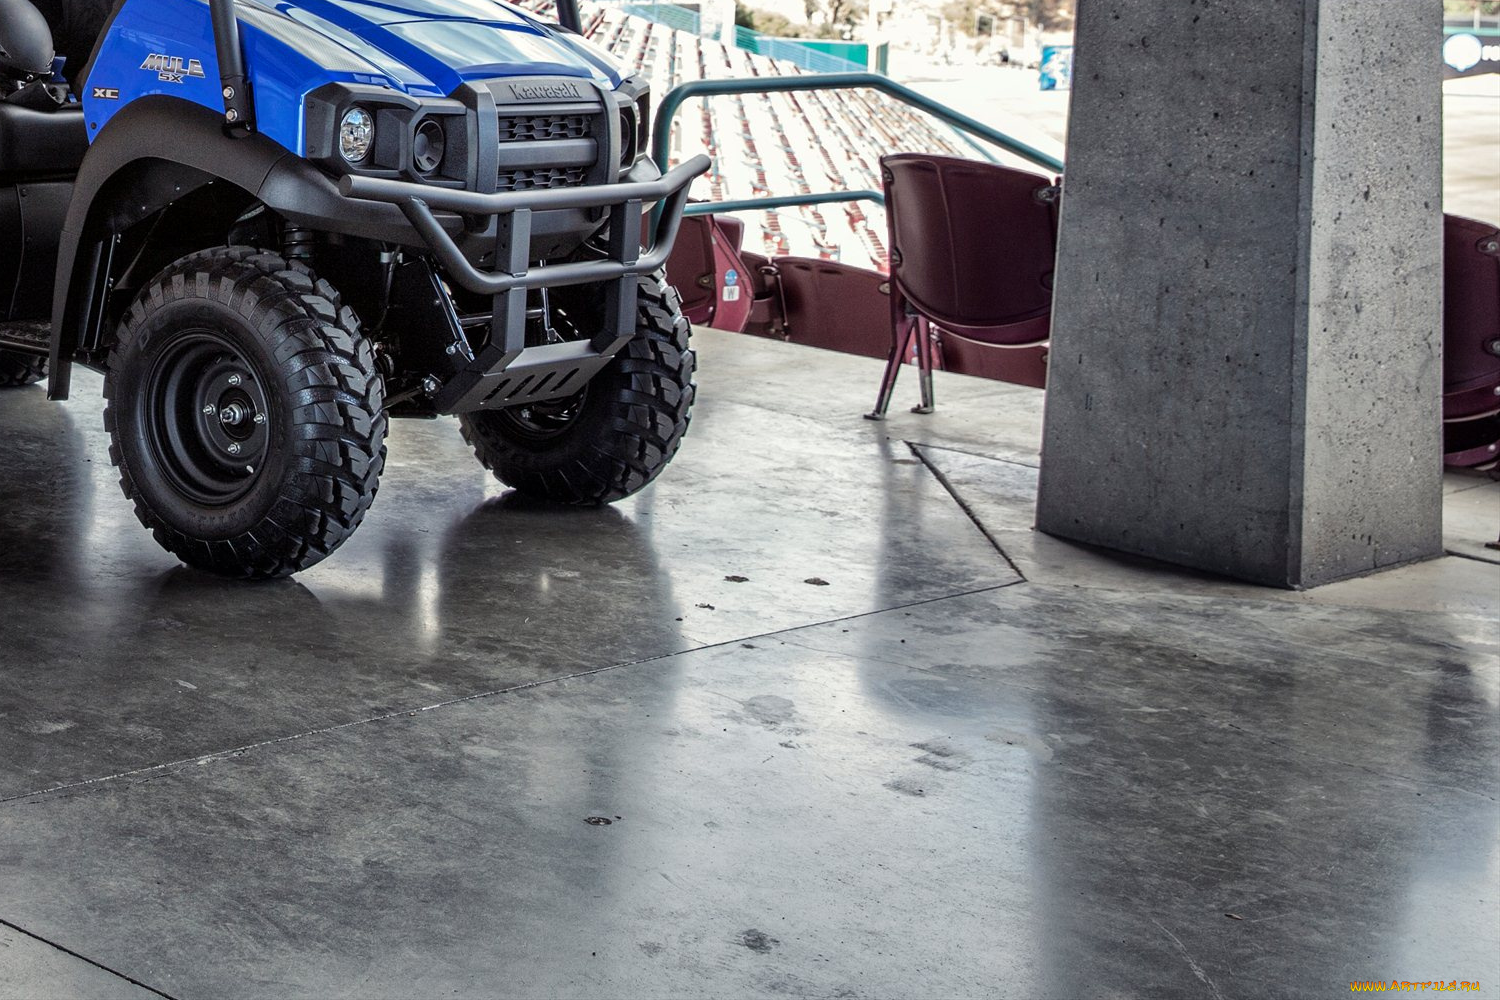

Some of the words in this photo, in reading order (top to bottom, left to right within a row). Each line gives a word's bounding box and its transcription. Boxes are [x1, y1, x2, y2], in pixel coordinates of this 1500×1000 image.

[139, 53, 205, 78] MULE
[158, 72, 183, 84] SX
[93, 88, 119, 99] XC
[508, 82, 582, 100] Kawasaki
